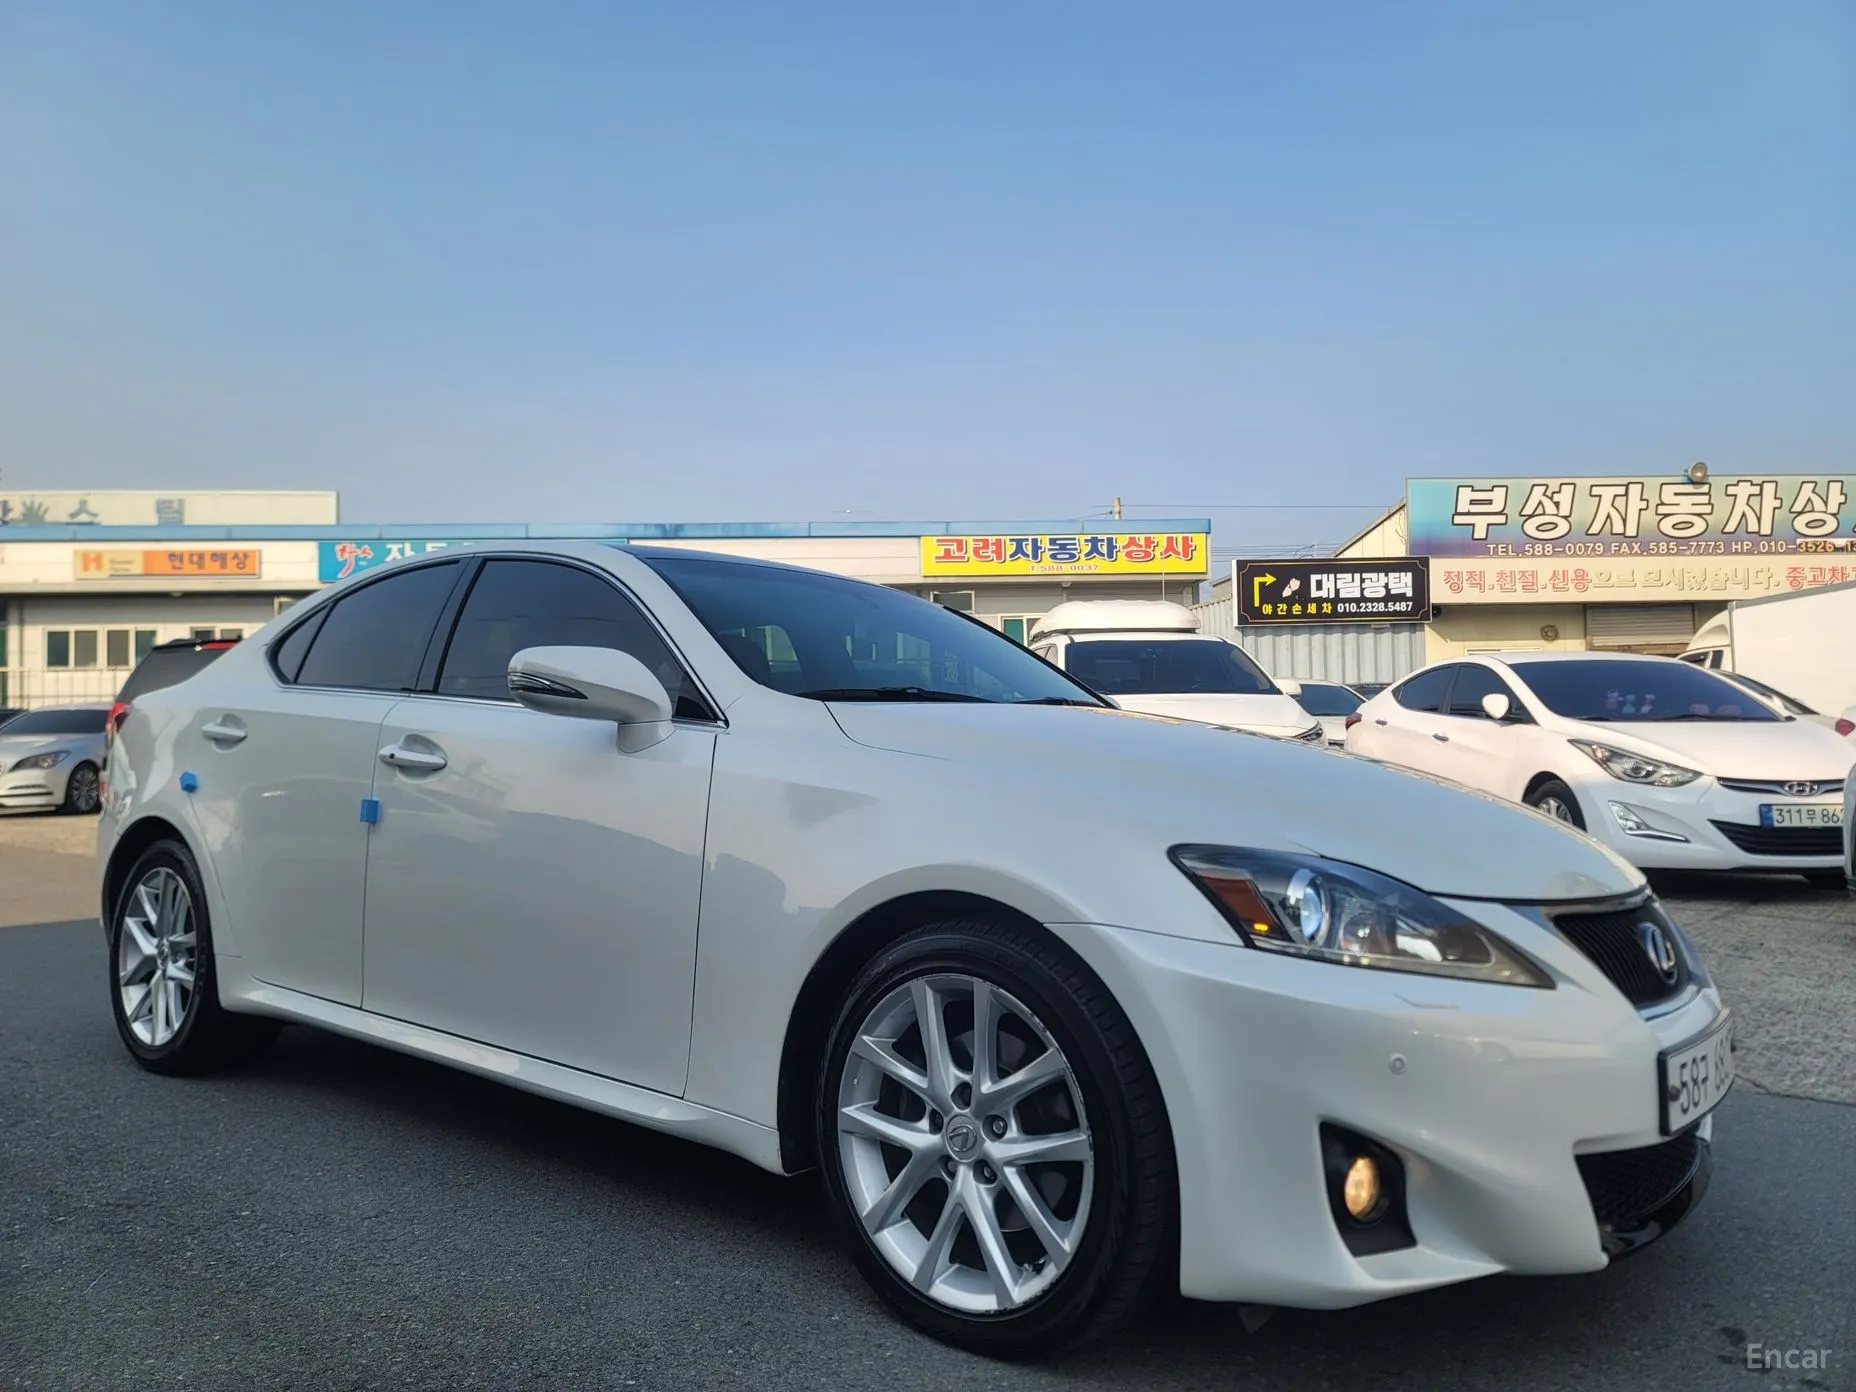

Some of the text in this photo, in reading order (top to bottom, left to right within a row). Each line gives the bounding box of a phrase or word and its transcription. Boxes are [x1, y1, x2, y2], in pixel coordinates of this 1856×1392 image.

[1452, 480, 1856, 540] 부성자동차상
[934, 535, 1196, 563] 고려자동차상사
[1487, 540, 1856, 556] TEL.588-0079 FAX.585-7773 HP.010-3526-1
[1309, 572, 1414, 599] 대림광택
[1337, 602, 1413, 613] 010.2328.5487
